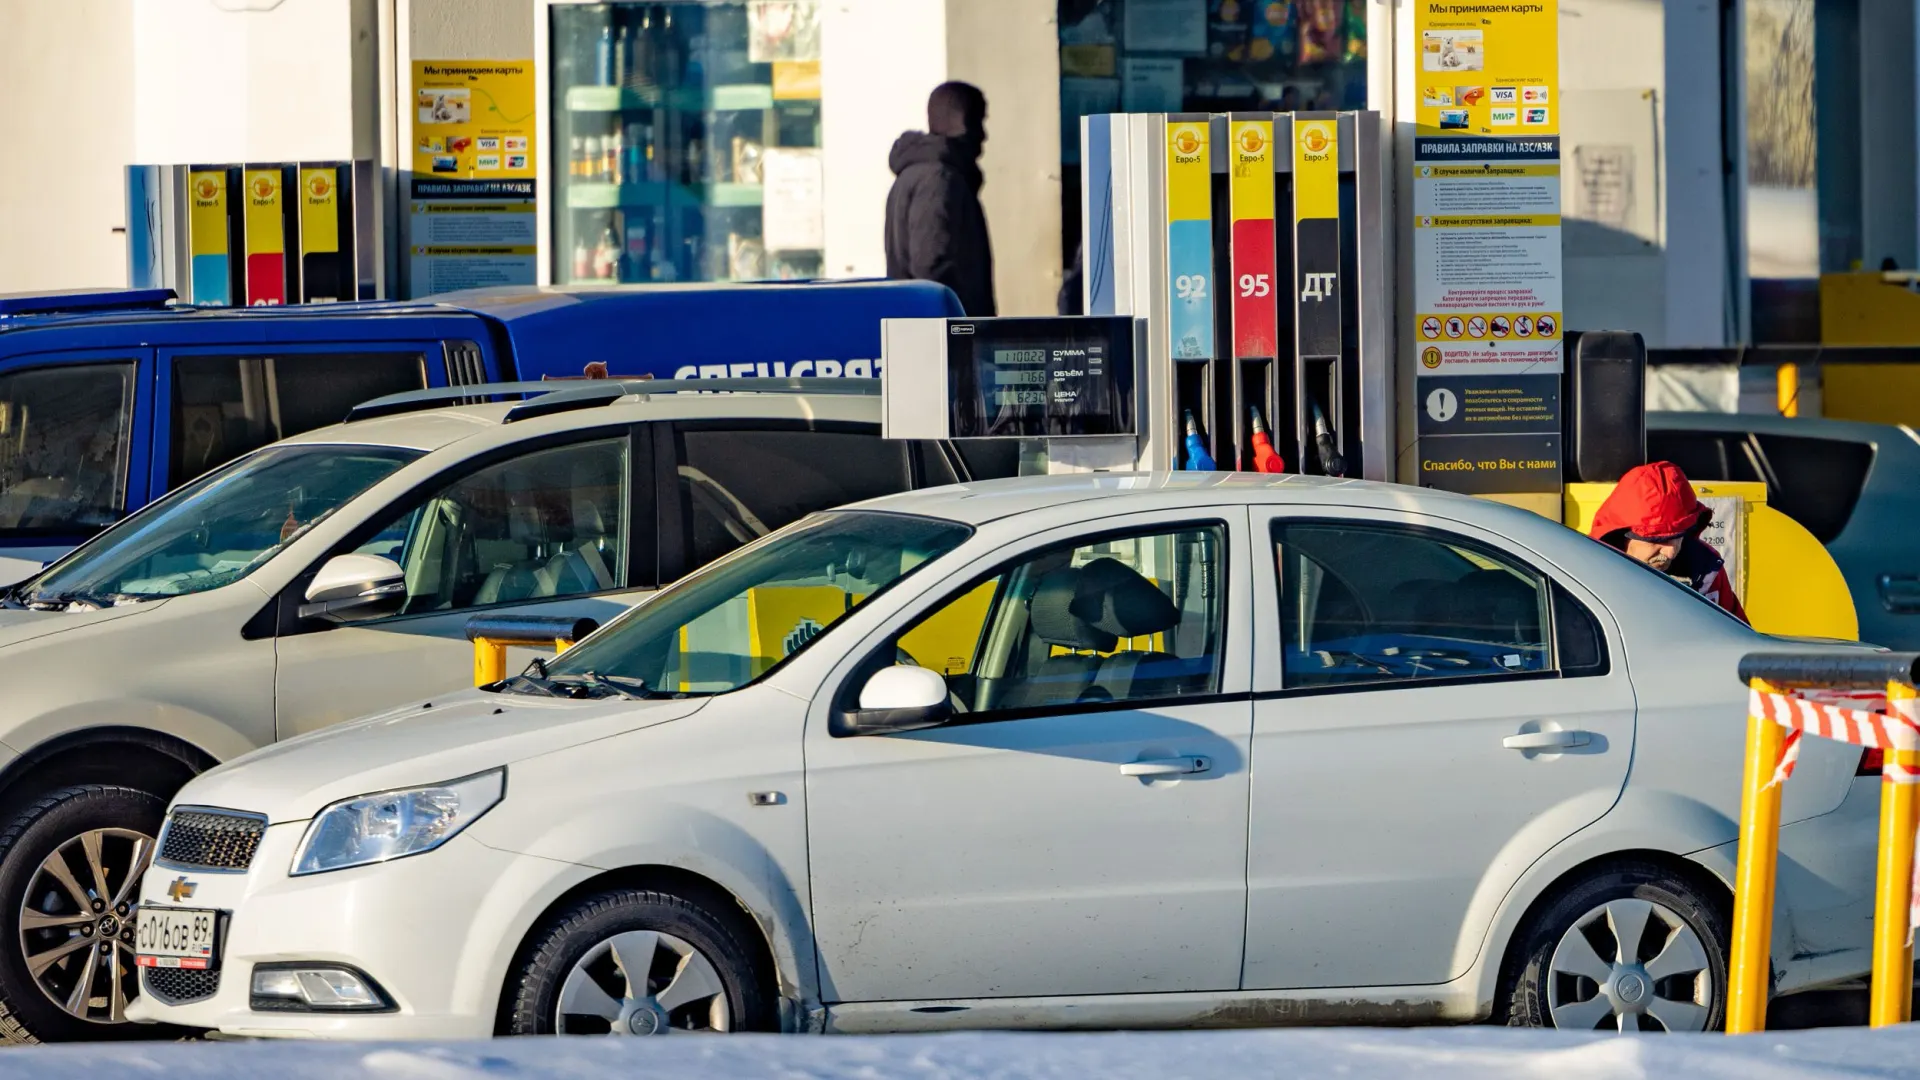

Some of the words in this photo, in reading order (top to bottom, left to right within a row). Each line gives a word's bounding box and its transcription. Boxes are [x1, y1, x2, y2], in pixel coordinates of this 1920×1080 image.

[1429, 4, 1447, 13] Мы
[1450, 5, 1509, 15] принимаем
[1511, 4, 1543, 14] карты
[424, 66, 440, 74] Мы
[441, 67, 493, 76] принимаем
[495, 67, 522, 76] карты
[1495, 91, 1513, 99] VISA
[1492, 113, 1515, 121] МИР
[1421, 143, 1460, 154] ПРАВИЛА
[1461, 143, 1504, 154] ЗАПРАВКИ
[1506, 143, 1518, 153] НА
[1519, 142, 1553, 153] АЗС/АЗК
[1175, 155, 1201, 164] Евро-5
[1239, 154, 1265, 163] Евро-5
[1304, 153, 1329, 162] Евро-5
[418, 184, 451, 193] ПРАВИЛА
[453, 184, 489, 193] ЗАПРАВКИ
[1440, 218, 1459, 226] случае
[1175, 274, 1207, 298] 92
[1239, 274, 1270, 298] 95
[1301, 273, 1337, 302] ДТ
[674, 359, 882, 391] СПЕЦСВЯ
[1053, 369, 1083, 377] ОБЪЁМ
[1423, 459, 1475, 471] Спасибо,
[1477, 461, 1497, 470] что
[1499, 459, 1516, 469] Вы
[1518, 461, 1525, 469] с
[1527, 460, 1557, 469] нами
[193, 916, 208, 942] 89
